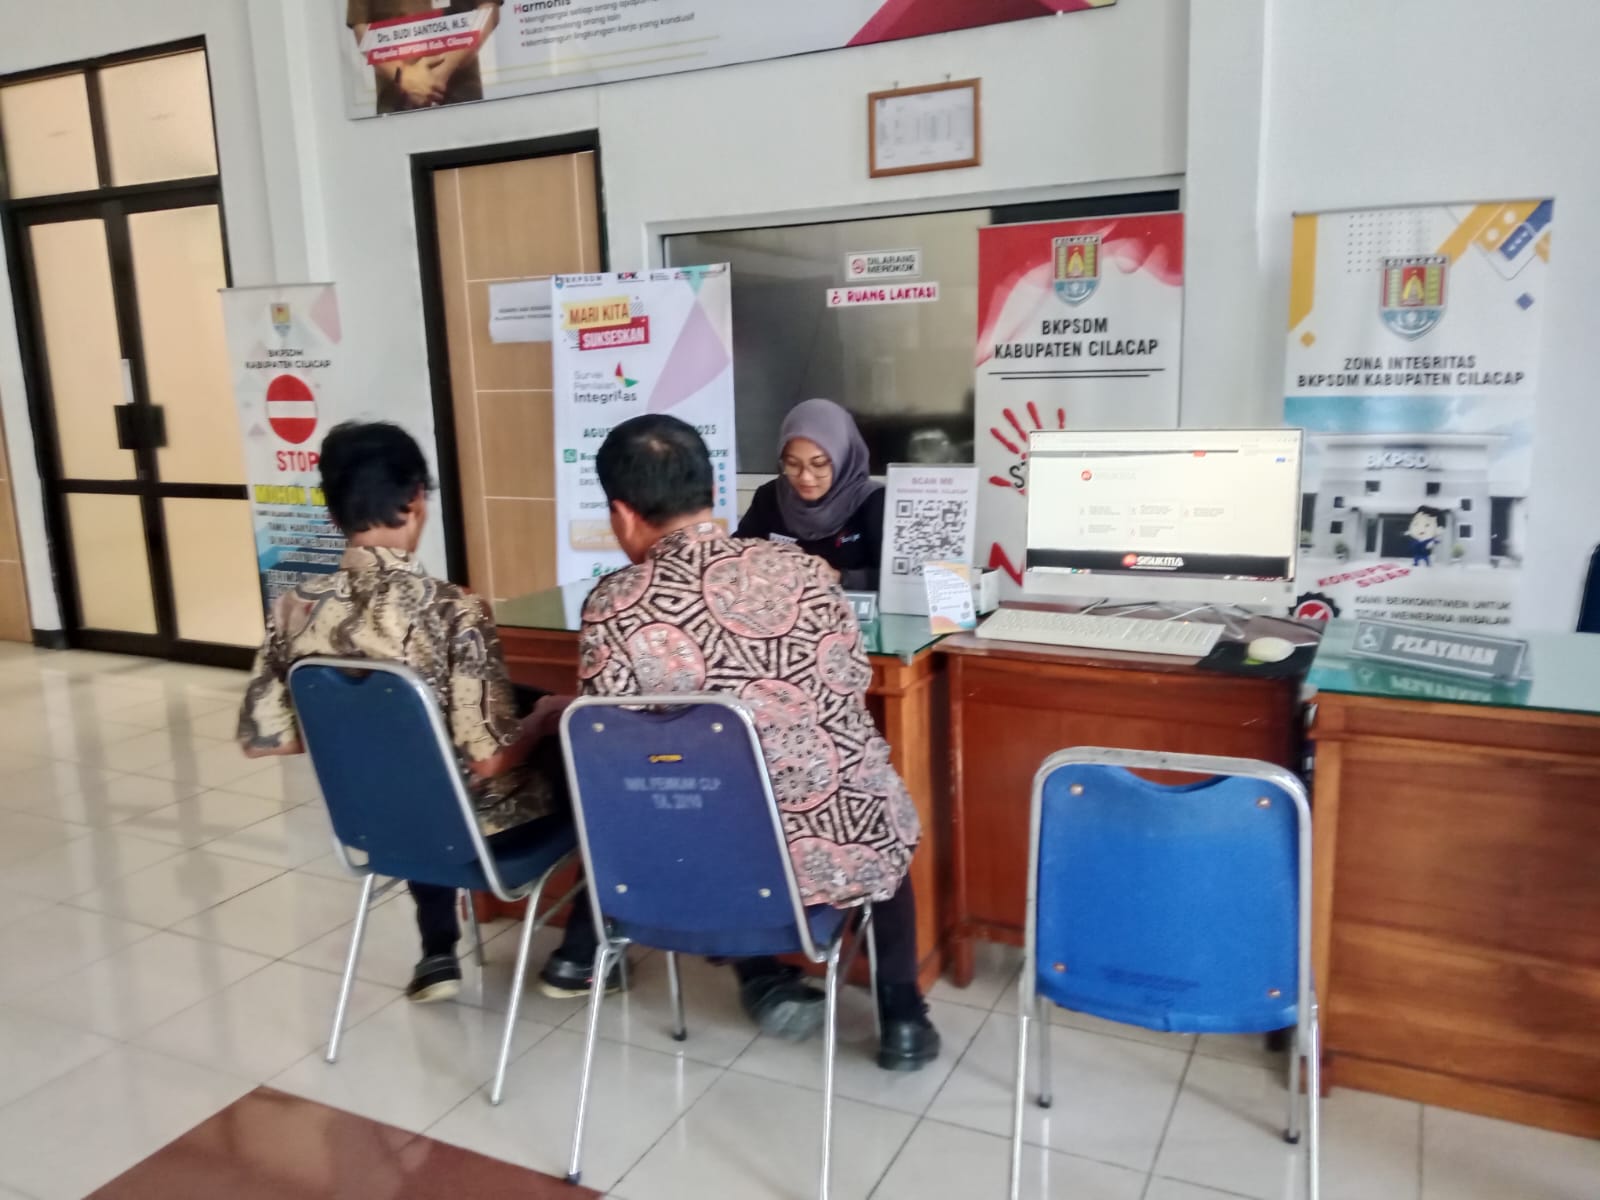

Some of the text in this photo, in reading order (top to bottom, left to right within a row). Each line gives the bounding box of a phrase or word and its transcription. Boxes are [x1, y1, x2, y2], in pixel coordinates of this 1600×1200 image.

[393, 27, 411, 40] BUDI
[867, 254, 915, 265] DILARANG
[617, 271, 639, 280] KPK
[847, 286, 937, 303] RUANG LAKTASI
[570, 306, 599, 325] MARI
[602, 303, 630, 322] KITA
[1041, 317, 1108, 335] BKPSDM
[994, 339, 1159, 359] KABUPATEN CILACAP
[1343, 355, 1476, 371] ZONA INTEGRITAS
[1297, 371, 1525, 387] BKPSDM KABUPATEN CILACAP
[574, 389, 638, 404] Integritas
[275, 450, 321, 473] STOP
[1391, 634, 1499, 666] PELAYANAN
